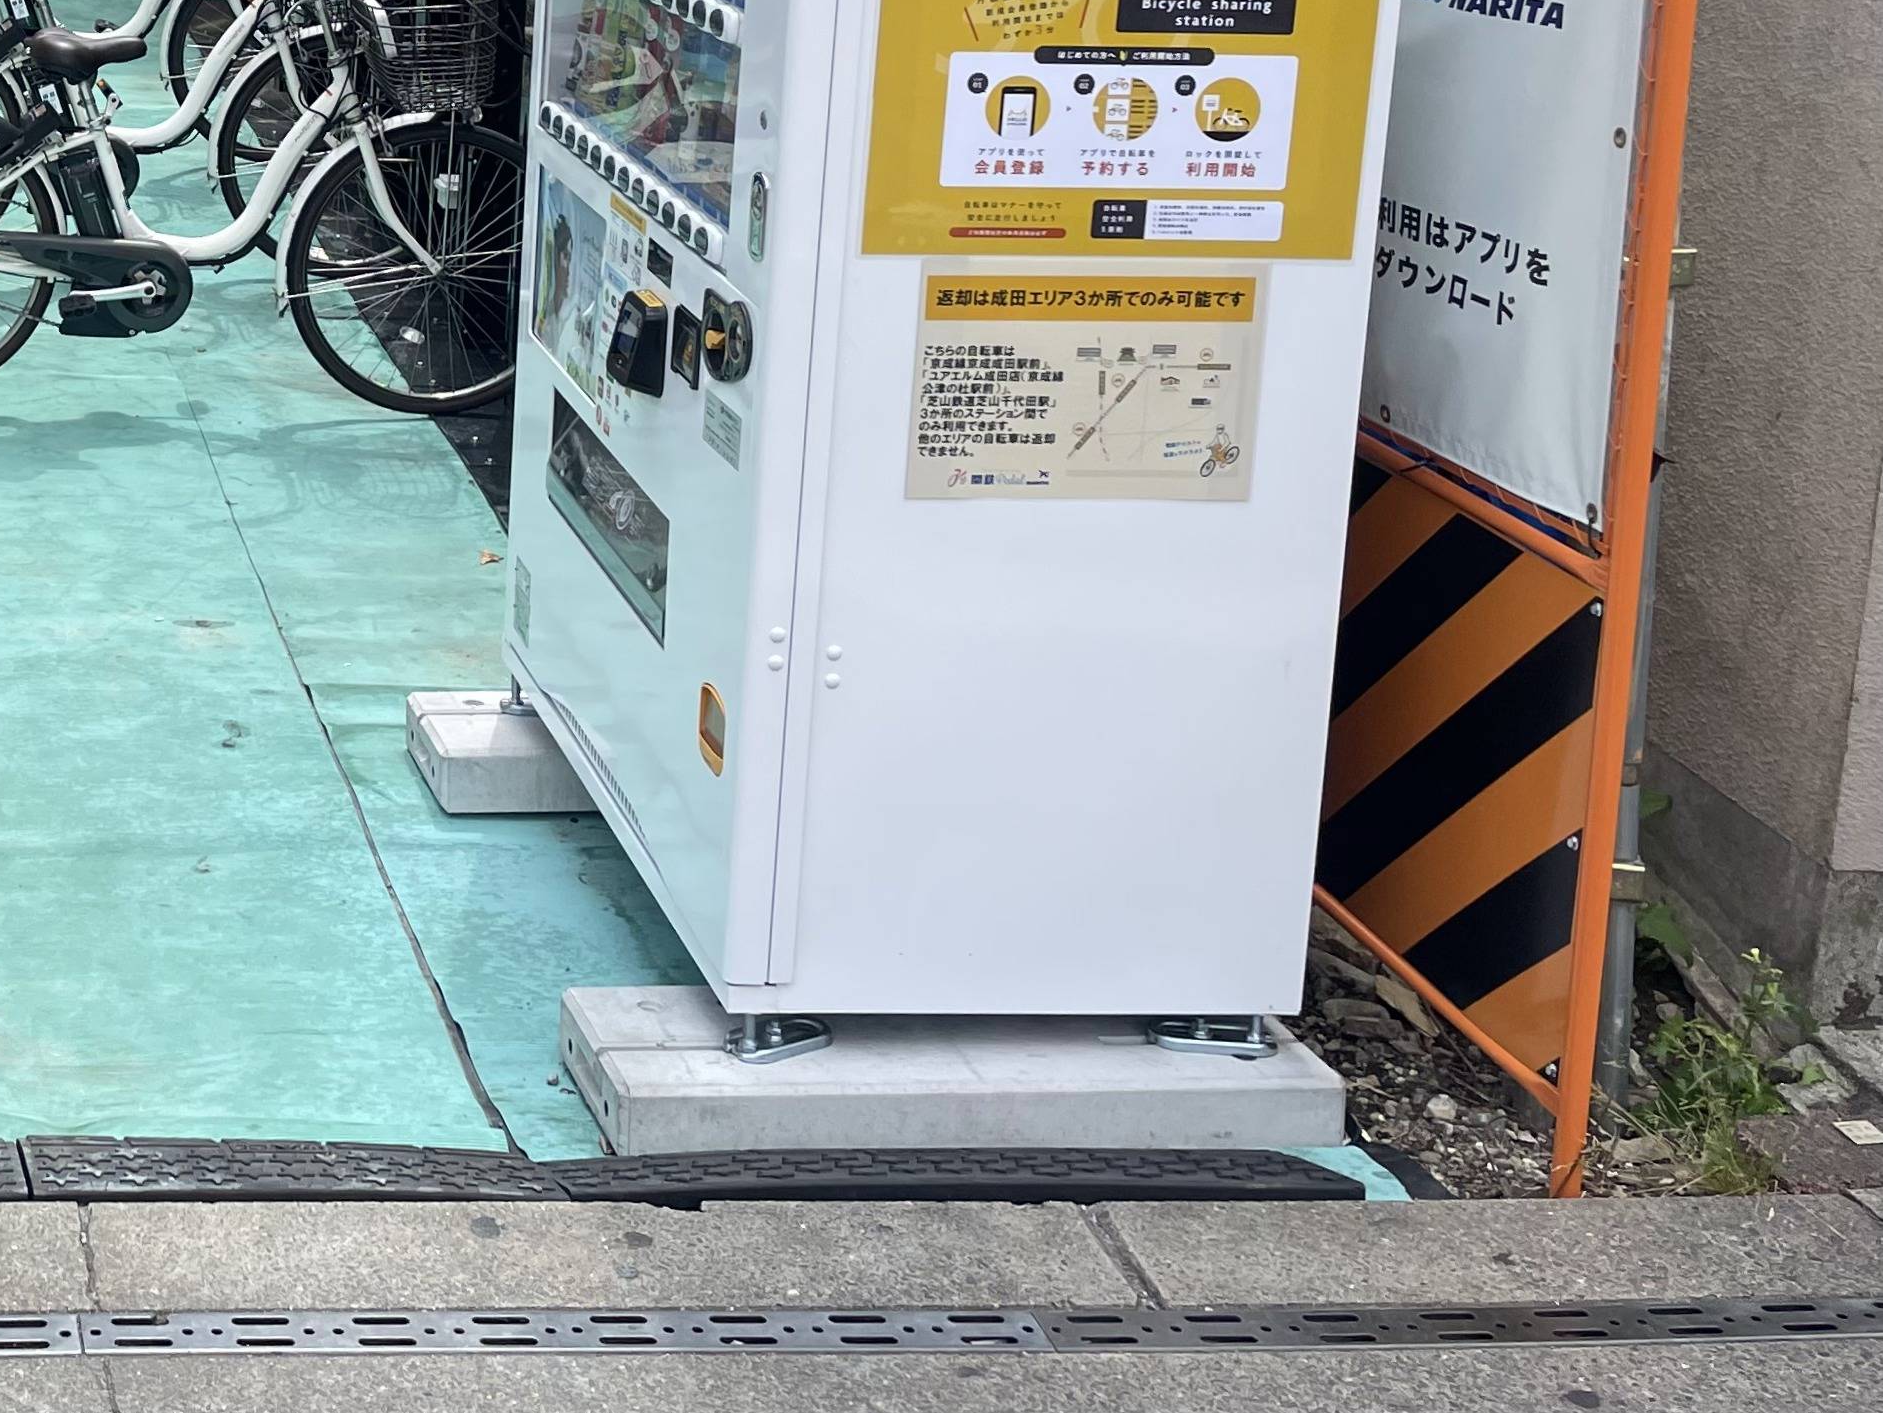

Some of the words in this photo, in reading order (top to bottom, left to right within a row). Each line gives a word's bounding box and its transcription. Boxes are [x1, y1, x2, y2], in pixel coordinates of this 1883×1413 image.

[1175, 14, 1235, 28] station
[974, 160, 1045, 175] 会員登録
[1081, 161, 1149, 176] 予約する
[1185, 162, 1256, 177] 利用開始
[1375, 245, 1516, 326] ダウンロード
[936, 289, 1246, 308] 返却は成田エリア3か所でのみ可能です
[924, 345, 1015, 356] こちらの自転車は
[918, 446, 974, 457] できません。
